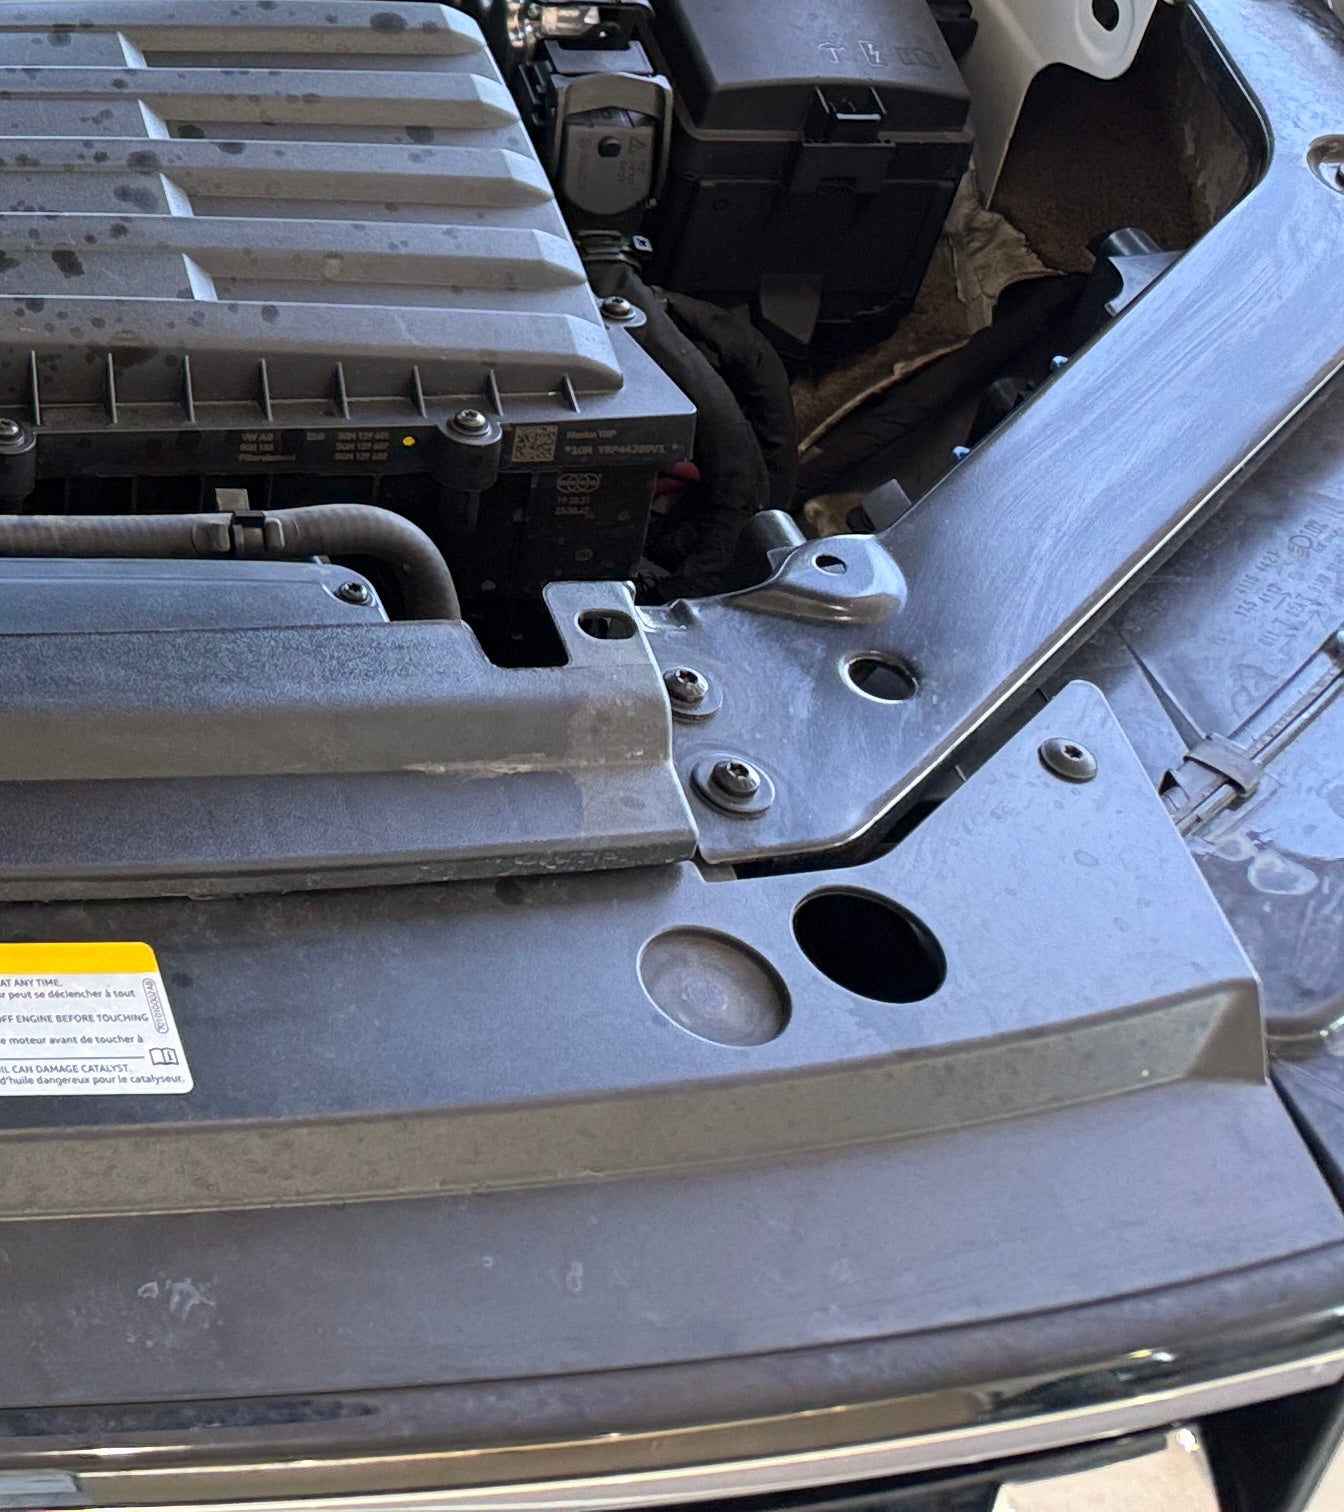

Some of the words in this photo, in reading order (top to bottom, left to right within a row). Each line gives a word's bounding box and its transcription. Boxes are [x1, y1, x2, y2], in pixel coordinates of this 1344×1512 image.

[0, 979, 12, 987] AT
[14, 979, 34, 987] ANY
[8, 991, 32, 1001] peut
[34, 991, 46, 999] se
[47, 989, 102, 999] déclencher
[105, 989, 112, 998] à
[112, 989, 136, 998] tout
[15, 1014, 54, 1024] ENGINE
[55, 1014, 95, 1023] BEFORE
[96, 1013, 149, 1023] TOUCHING
[8, 1036, 46, 1045] moteur
[49, 1036, 78, 1044] avant
[79, 1035, 93, 1044] de
[94, 1035, 134, 1044] toucher
[137, 1034, 144, 1043] à
[11, 1065, 34, 1074] CAN
[35, 1064, 79, 1074] DAMAGE
[0, 1076, 35, 1086] d'huile
[36, 1075, 90, 1087] dangereux
[92, 1076, 116, 1086] pour
[117, 1075, 128, 1084] le
